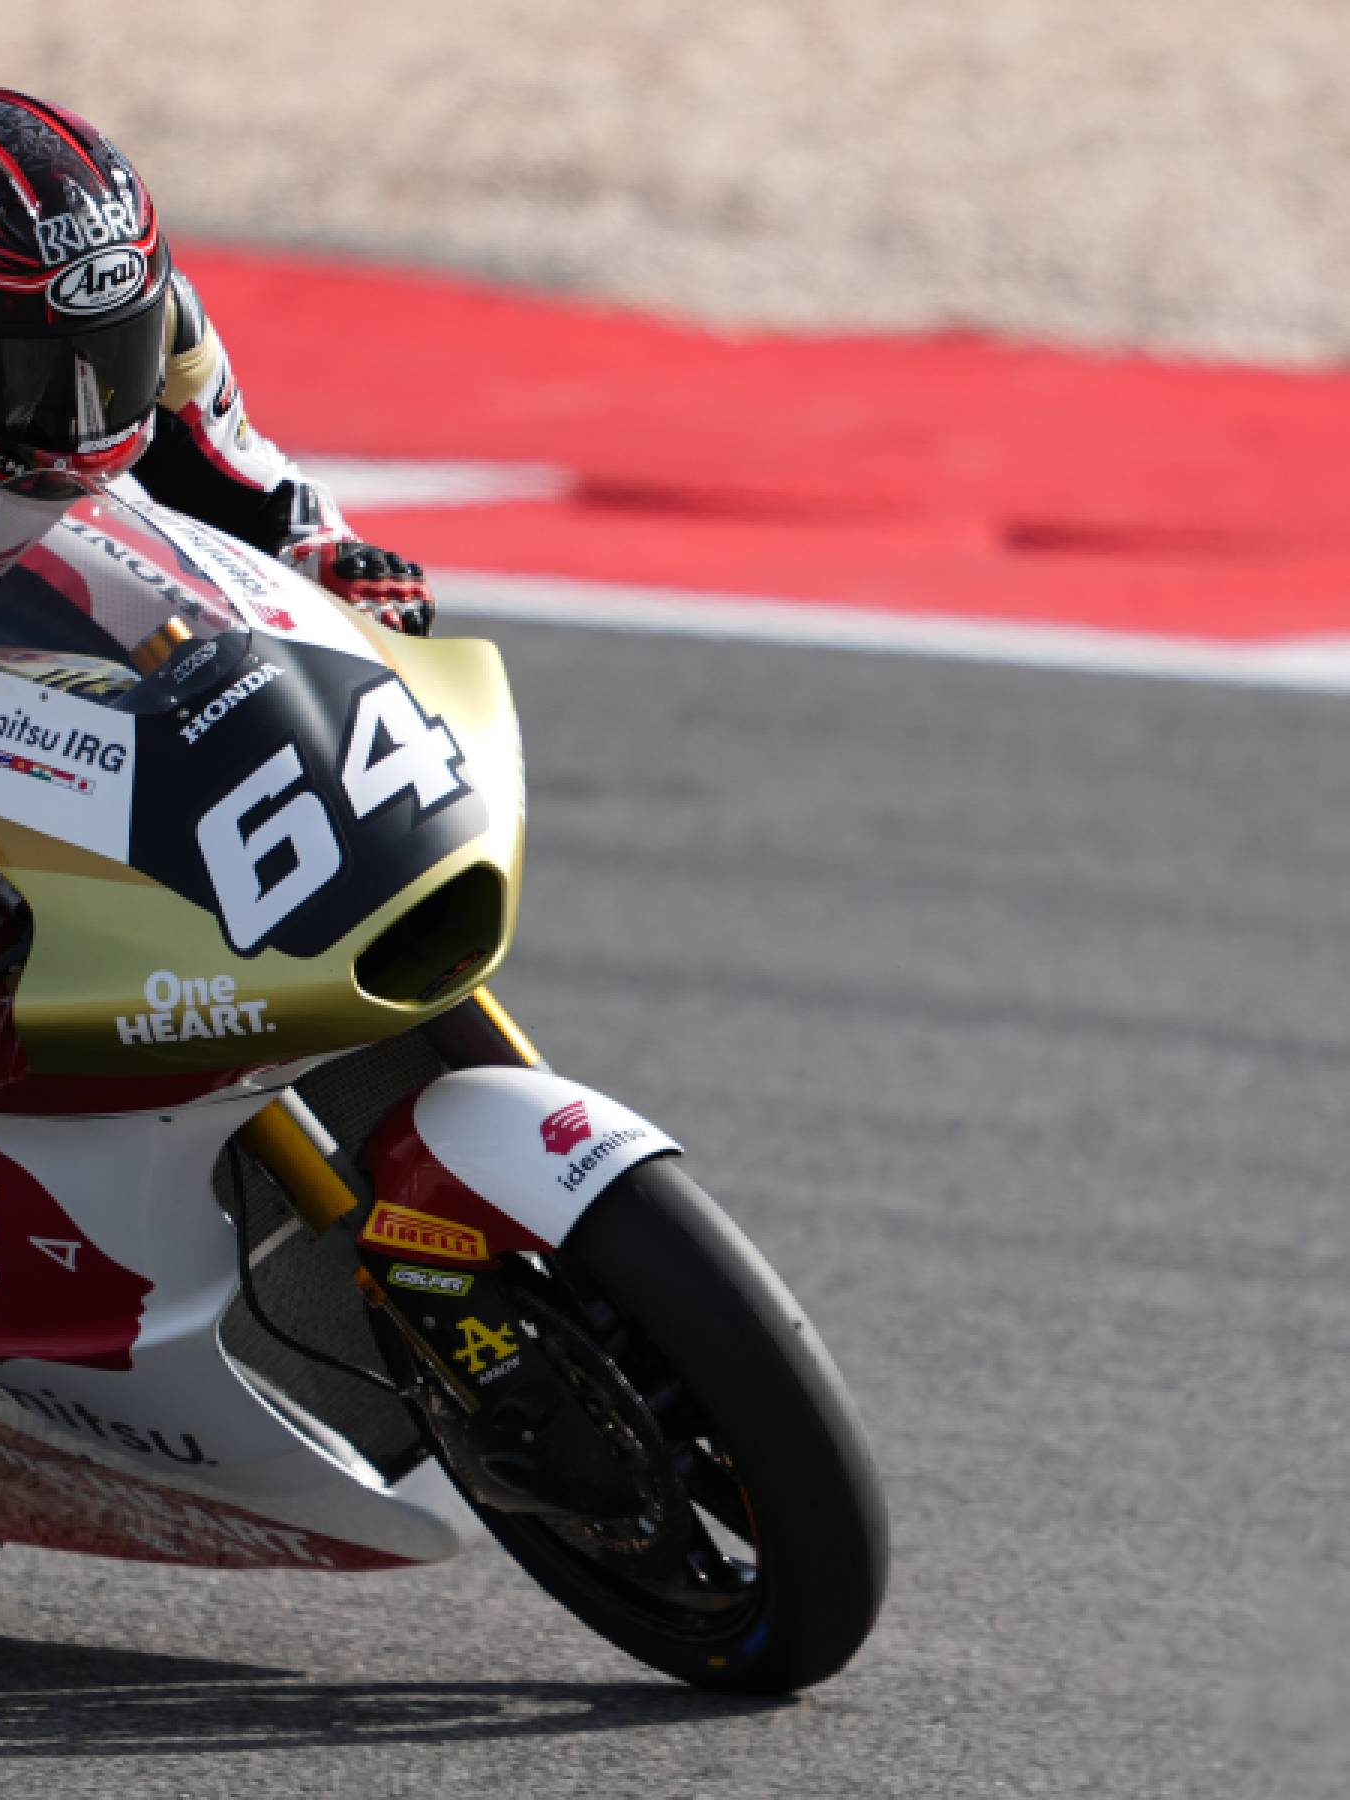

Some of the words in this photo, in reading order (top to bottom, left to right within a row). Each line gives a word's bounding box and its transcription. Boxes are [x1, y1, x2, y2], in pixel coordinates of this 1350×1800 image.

[70, 258, 137, 297] Arai
[180, 661, 284, 744] HONDA
[60, 730, 127, 774] IRG
[196, 678, 464, 951] 64
[144, 970, 237, 1009] One
[116, 1002, 276, 1045] HEART.
[557, 1124, 648, 1193] idemitsu
[370, 1207, 480, 1258] PIRELLI
